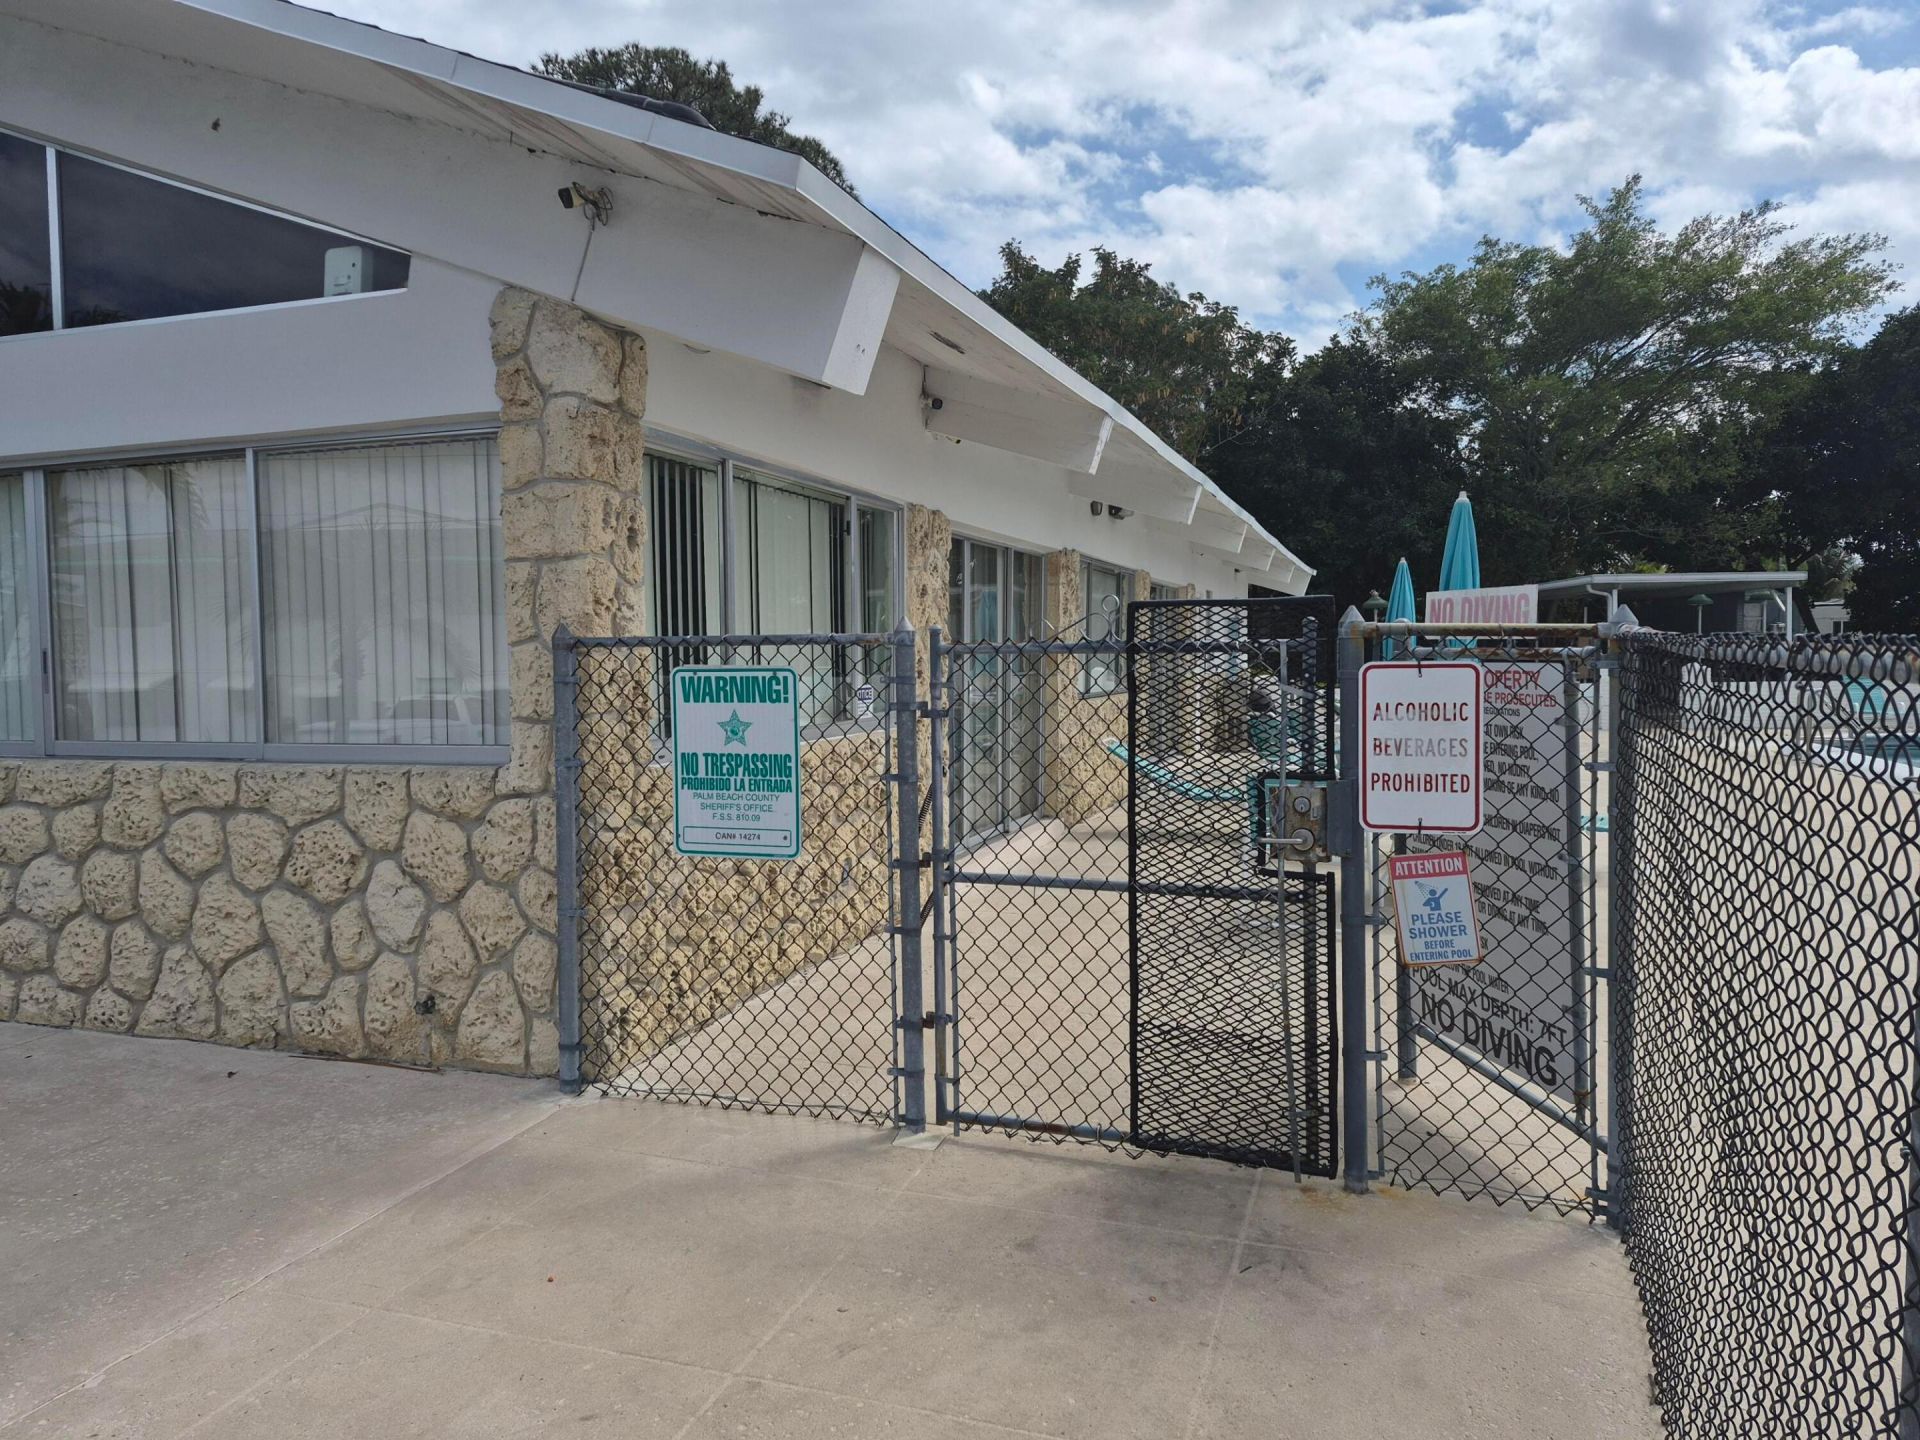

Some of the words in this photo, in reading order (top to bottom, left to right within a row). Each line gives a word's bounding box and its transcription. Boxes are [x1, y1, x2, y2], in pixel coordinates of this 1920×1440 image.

[1430, 597, 1454, 623] NO
[1461, 593, 1530, 623] DIVING
[681, 676, 789, 703] WARNING!
[1495, 692, 1556, 707] PROSECUTED
[1373, 702, 1469, 721] ALCOHOLIC
[1484, 707, 1520, 717] EGUATIONS
[1373, 738, 1468, 757] BEVERAGES
[681, 752, 698, 776] NO
[703, 753, 792, 778] TRESPASSING
[681, 777, 731, 791] PROHIBIDO
[734, 778, 745, 792] LA
[749, 778, 792, 793] ENTRADA
[1371, 772, 1470, 793] PROHIBITED
[693, 792, 714, 800] PALM
[716, 792, 743, 801] BEACH
[745, 793, 780, 802] COUNTY
[700, 802, 741, 811] SHERIFF'S
[743, 803, 773, 812] OFFICE
[1396, 857, 1464, 876] ATTENTION
[1411, 911, 1463, 926] PLEASE
[1409, 924, 1468, 940] SHOWER
[1424, 939, 1455, 950] BEFORE
[1410, 950, 1449, 961] ENTERING
[1451, 948, 1473, 959] POOL
[1413, 966, 1445, 991] POOL
[1449, 978, 1477, 1007] MAX
[1421, 989, 1454, 1032] NO
[1464, 1010, 1557, 1086] DIVING
